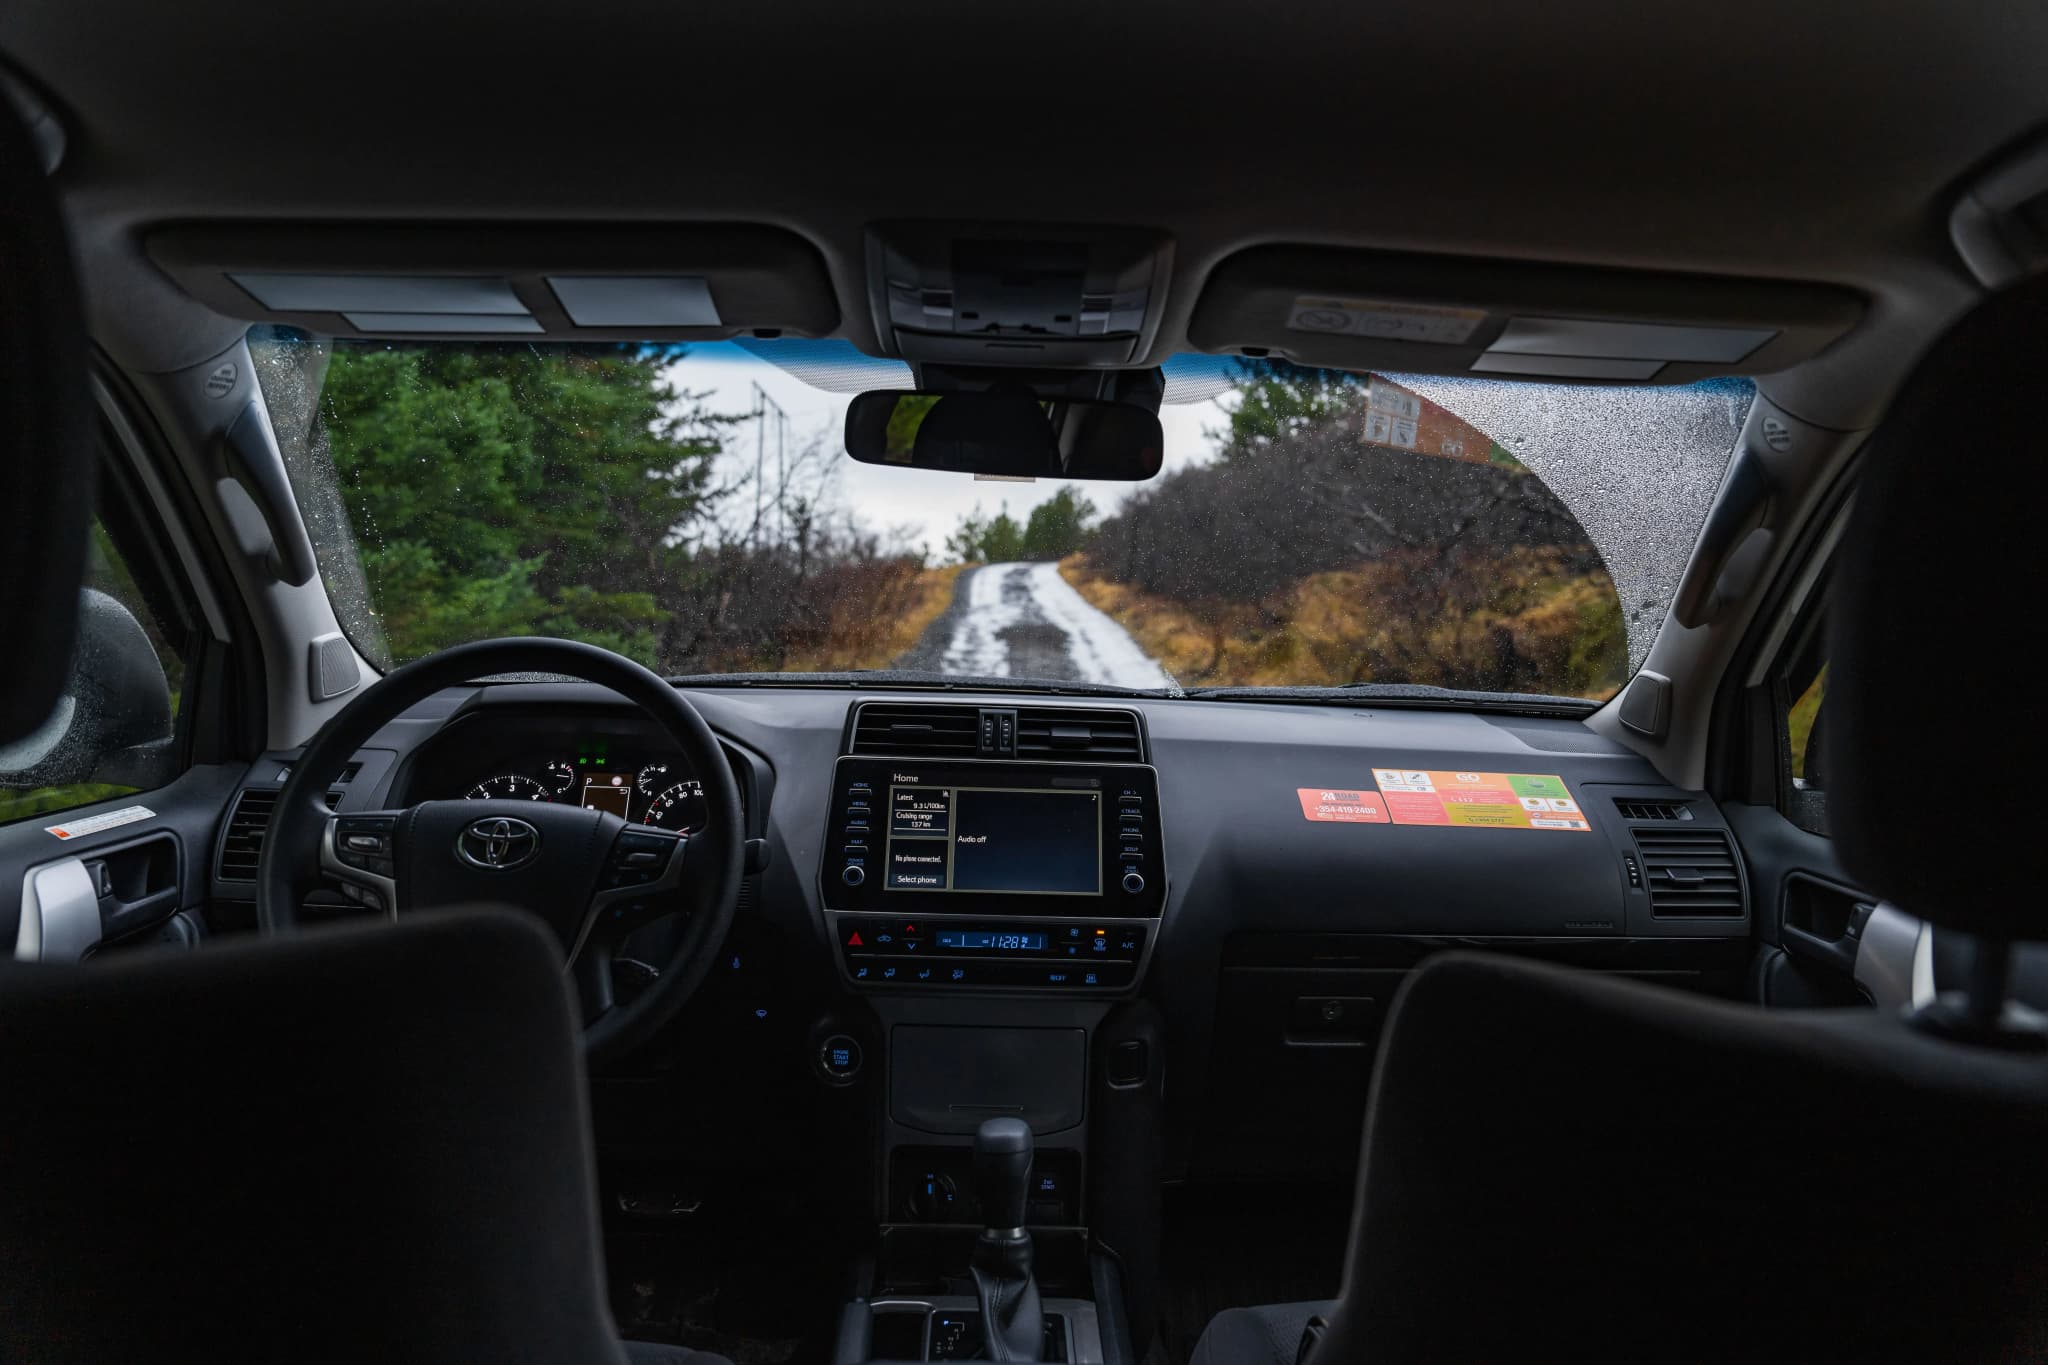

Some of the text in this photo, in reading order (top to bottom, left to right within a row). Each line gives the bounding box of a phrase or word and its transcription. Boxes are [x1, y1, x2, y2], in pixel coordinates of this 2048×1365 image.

[893, 773, 919, 783] Home
[508, 784, 515, 792] 3
[483, 792, 491, 800] 2
[896, 793, 914, 801] Latest
[896, 811, 933, 821] Cruising range
[958, 835, 987, 843] Audio off
[903, 855, 917, 863] phone
[897, 875, 937, 885] Select phone
[1122, 941, 1134, 949] A/C
